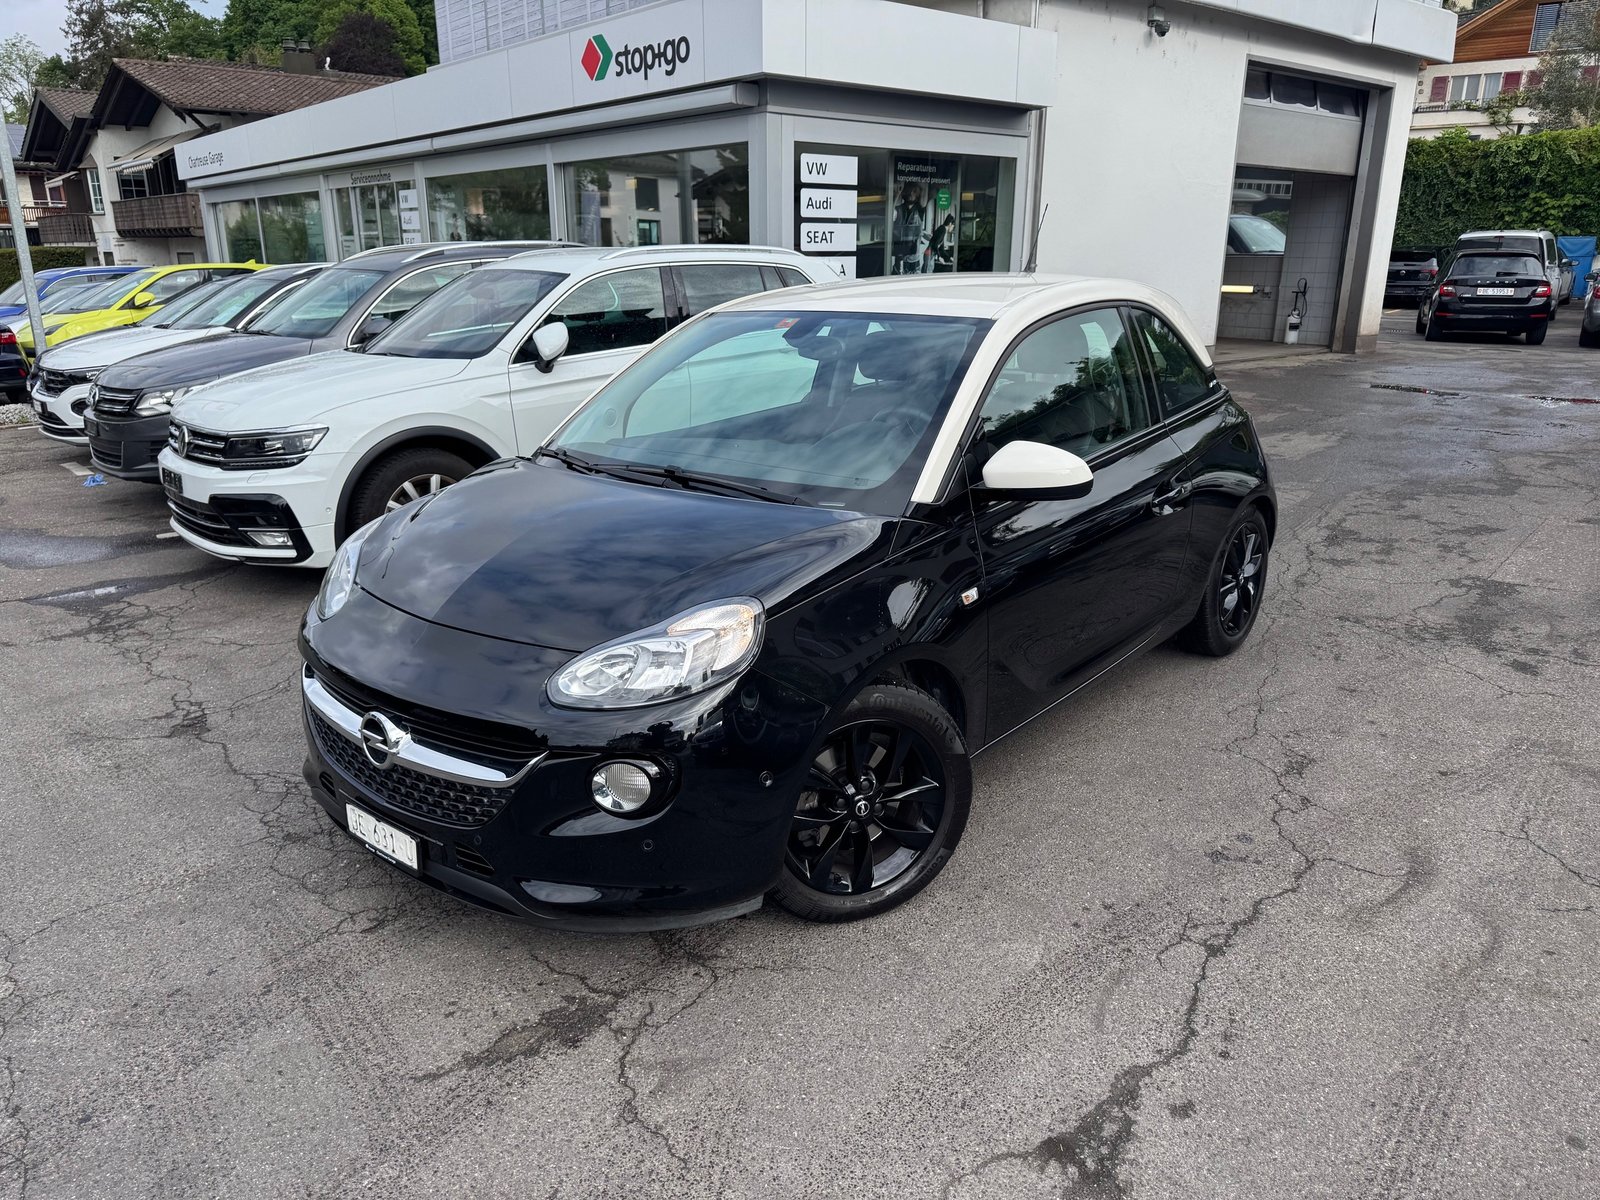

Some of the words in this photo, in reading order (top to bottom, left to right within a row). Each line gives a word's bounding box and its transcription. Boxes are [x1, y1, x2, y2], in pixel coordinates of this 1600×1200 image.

[614, 36, 691, 80] stop+go
[208, 151, 224, 166] Garage
[806, 161, 828, 176] VW
[897, 161, 937, 173] Reparaturen
[350, 169, 392, 185] Serviceannahme
[897, 174, 921, 183] kompetent
[921, 175, 931, 183] und
[931, 177, 951, 185] preiswert
[806, 196, 833, 210] Audi
[806, 230, 835, 244] SEAT
[373, 823, 396, 854] 631
